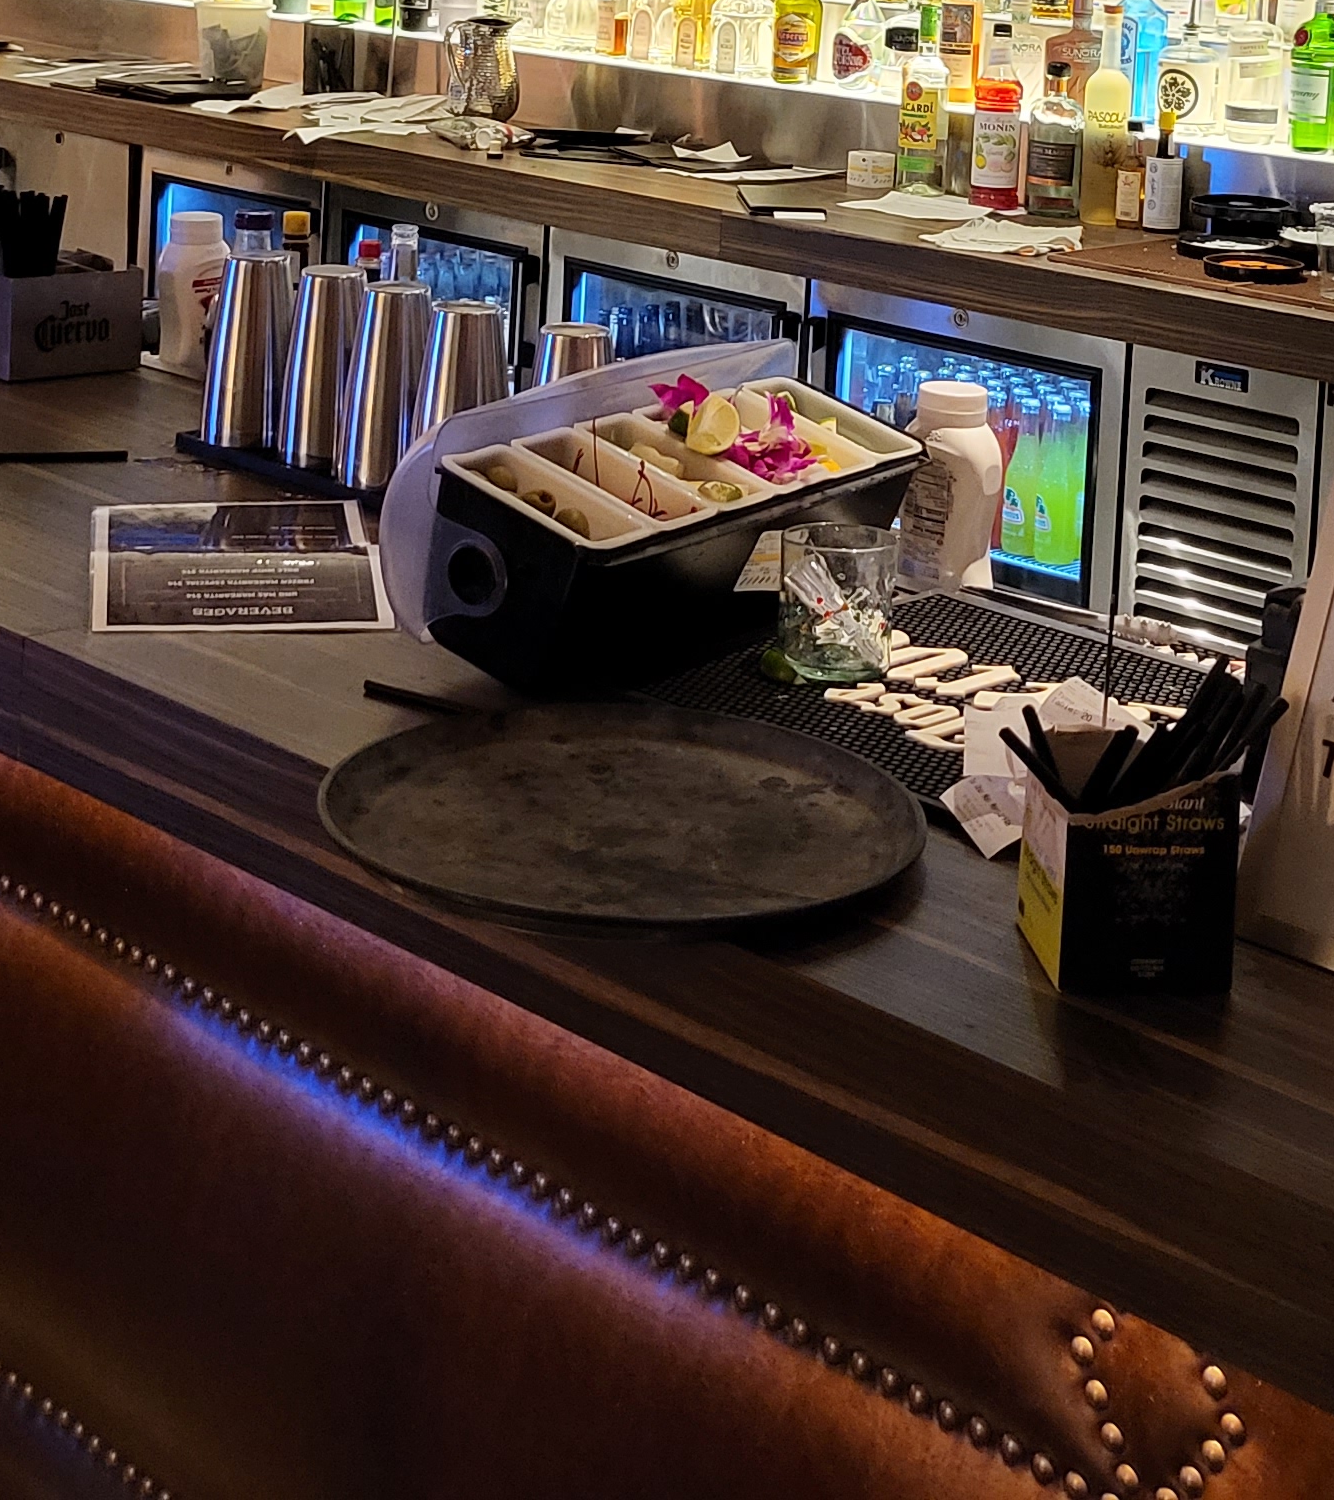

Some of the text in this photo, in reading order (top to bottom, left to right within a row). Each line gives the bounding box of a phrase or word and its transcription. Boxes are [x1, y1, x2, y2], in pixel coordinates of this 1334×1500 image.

[979, 122, 1016, 132] MONIN
[34, 314, 110, 352] Cuervo
[1199, 365, 1242, 392] KROWNE
[192, 606, 294, 617] BEVERAGES
[1166, 815, 1226, 832] Straws
[1102, 844, 1123, 855] 150
[1170, 845, 1206, 856] Straws
